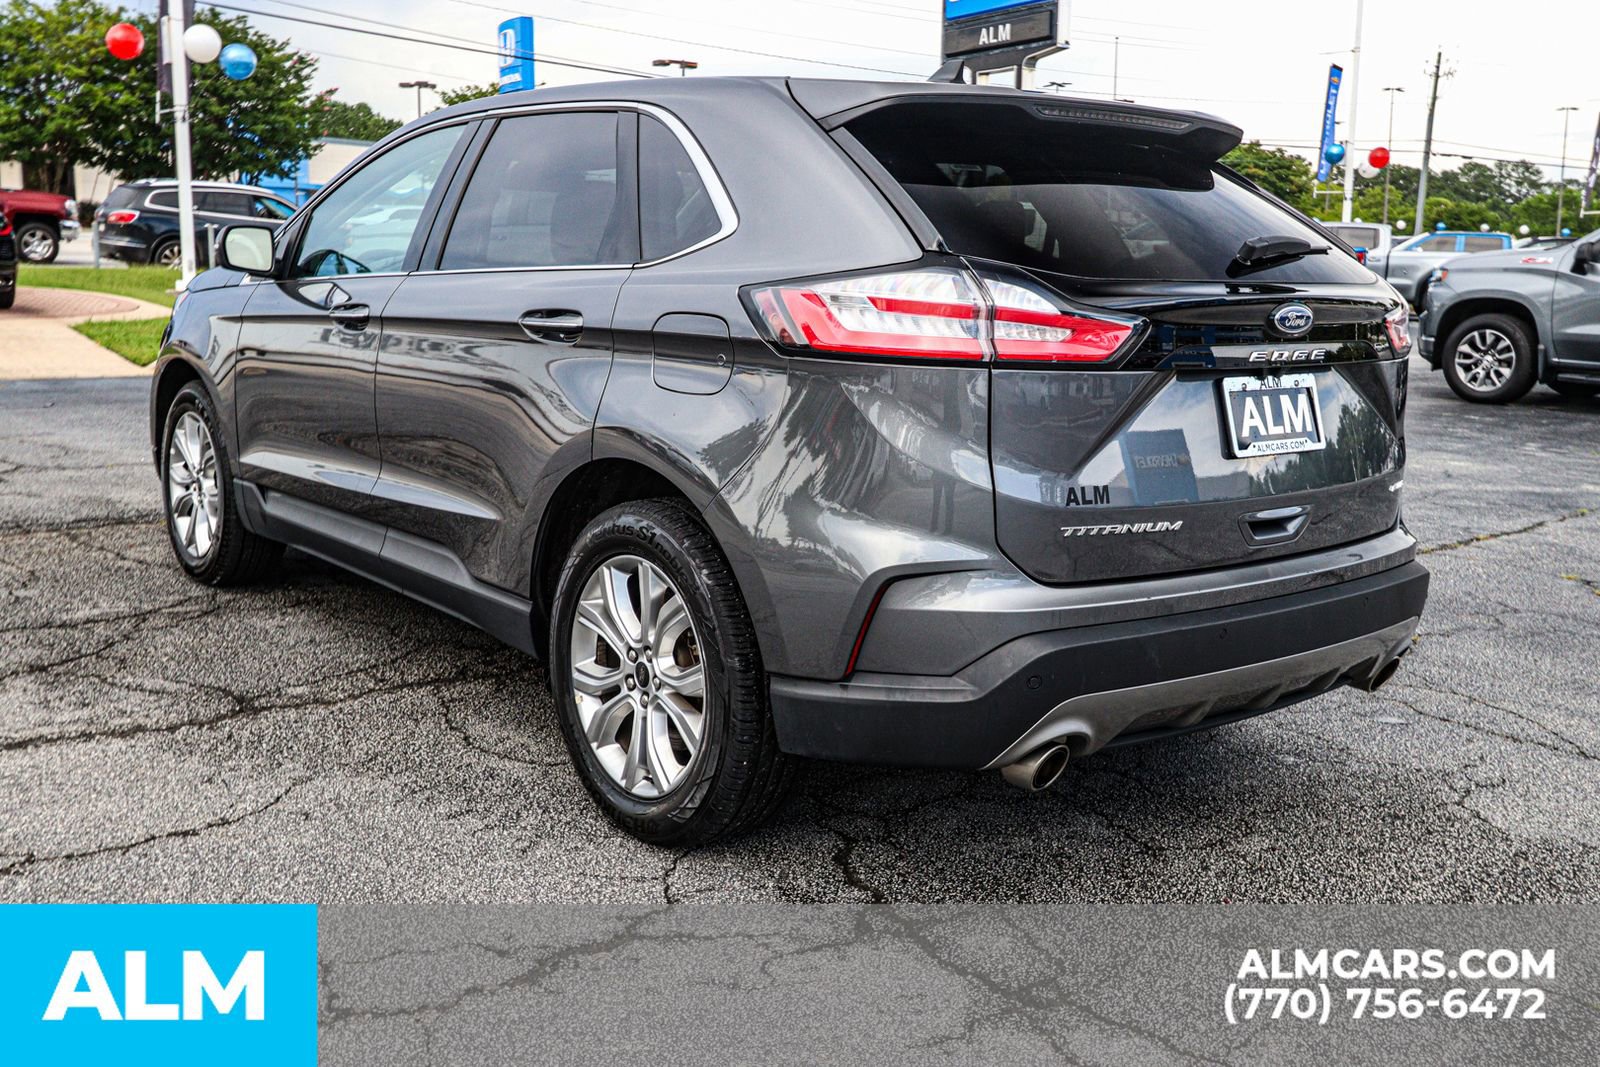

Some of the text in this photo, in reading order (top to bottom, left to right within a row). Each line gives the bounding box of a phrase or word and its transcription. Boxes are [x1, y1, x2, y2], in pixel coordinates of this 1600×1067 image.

[979, 23, 1011, 45] ALM
[1285, 311, 1307, 327] Ford
[1249, 349, 1326, 362] EDGE
[1260, 376, 1282, 389] ALM
[1241, 393, 1313, 437] ALM
[1257, 441, 1306, 453] ALMCARS.COM
[1065, 485, 1110, 506] ALM
[1060, 520, 1183, 537] TITANIUM
